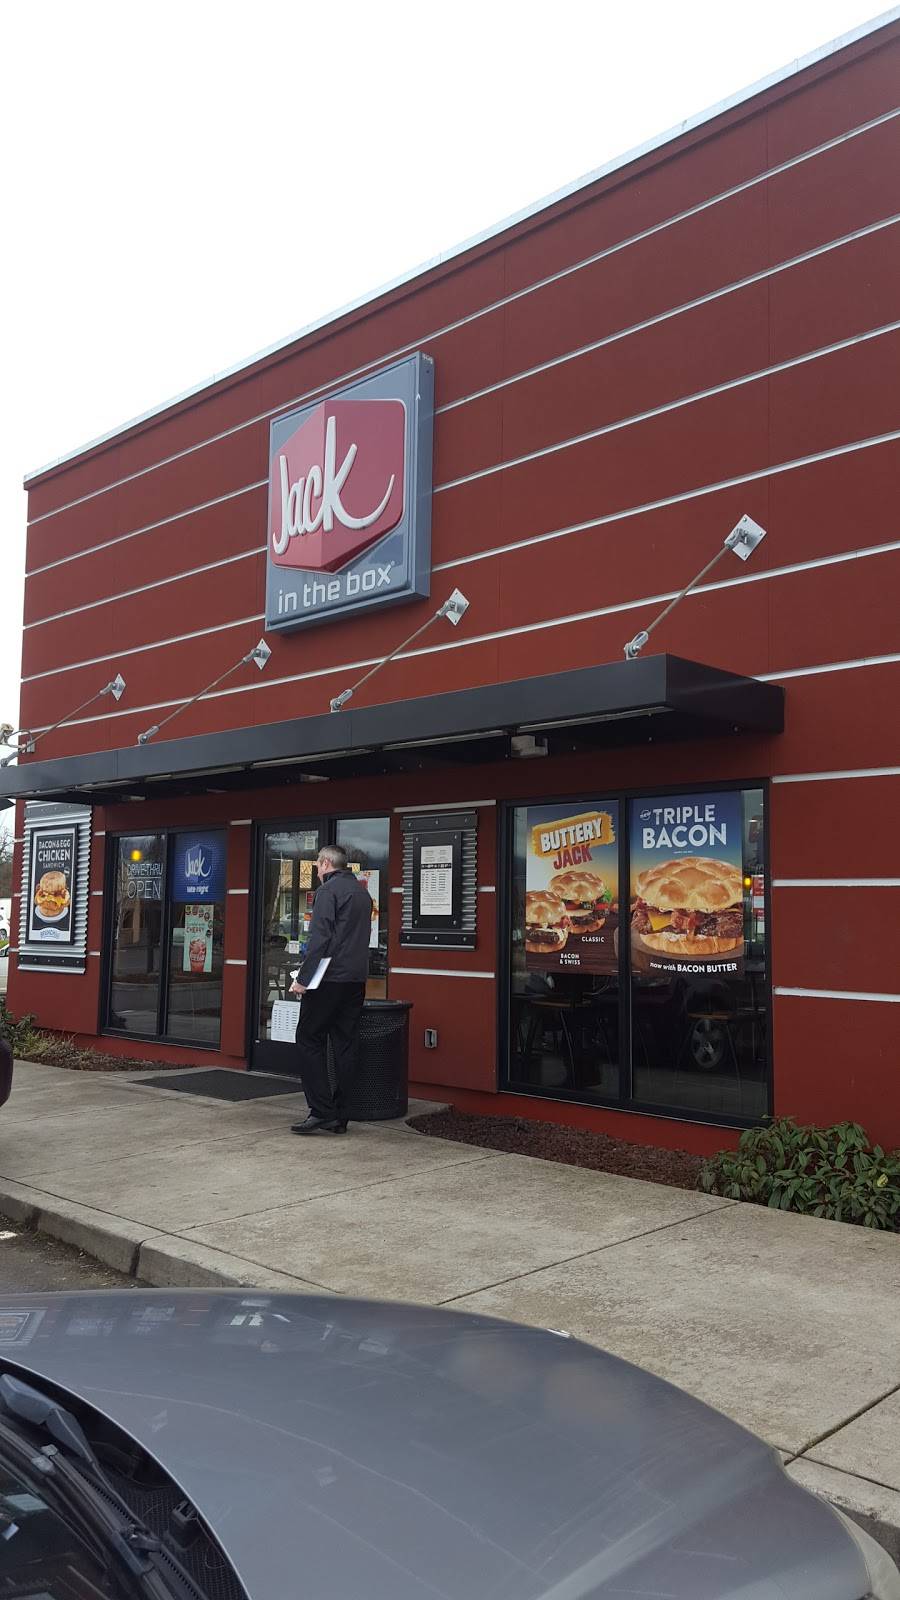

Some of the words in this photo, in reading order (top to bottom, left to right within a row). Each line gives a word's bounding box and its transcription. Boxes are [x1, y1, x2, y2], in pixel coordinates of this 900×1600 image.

[272, 415, 395, 556] Jack
[278, 589, 298, 615] in
[303, 579, 340, 609] the
[346, 570, 391, 595] box
[653, 804, 716, 825] TRIPLE
[540, 817, 602, 853] BUTTERY
[642, 823, 727, 849] BACON
[38, 849, 71, 862] CHICKEN
[185, 849, 212, 877] Jack
[553, 843, 593, 870] JACK
[127, 880, 161, 899] OPEN
[663, 964, 676, 972] with
[676, 963, 706, 973] BACON
[706, 962, 738, 973] BUTTER
